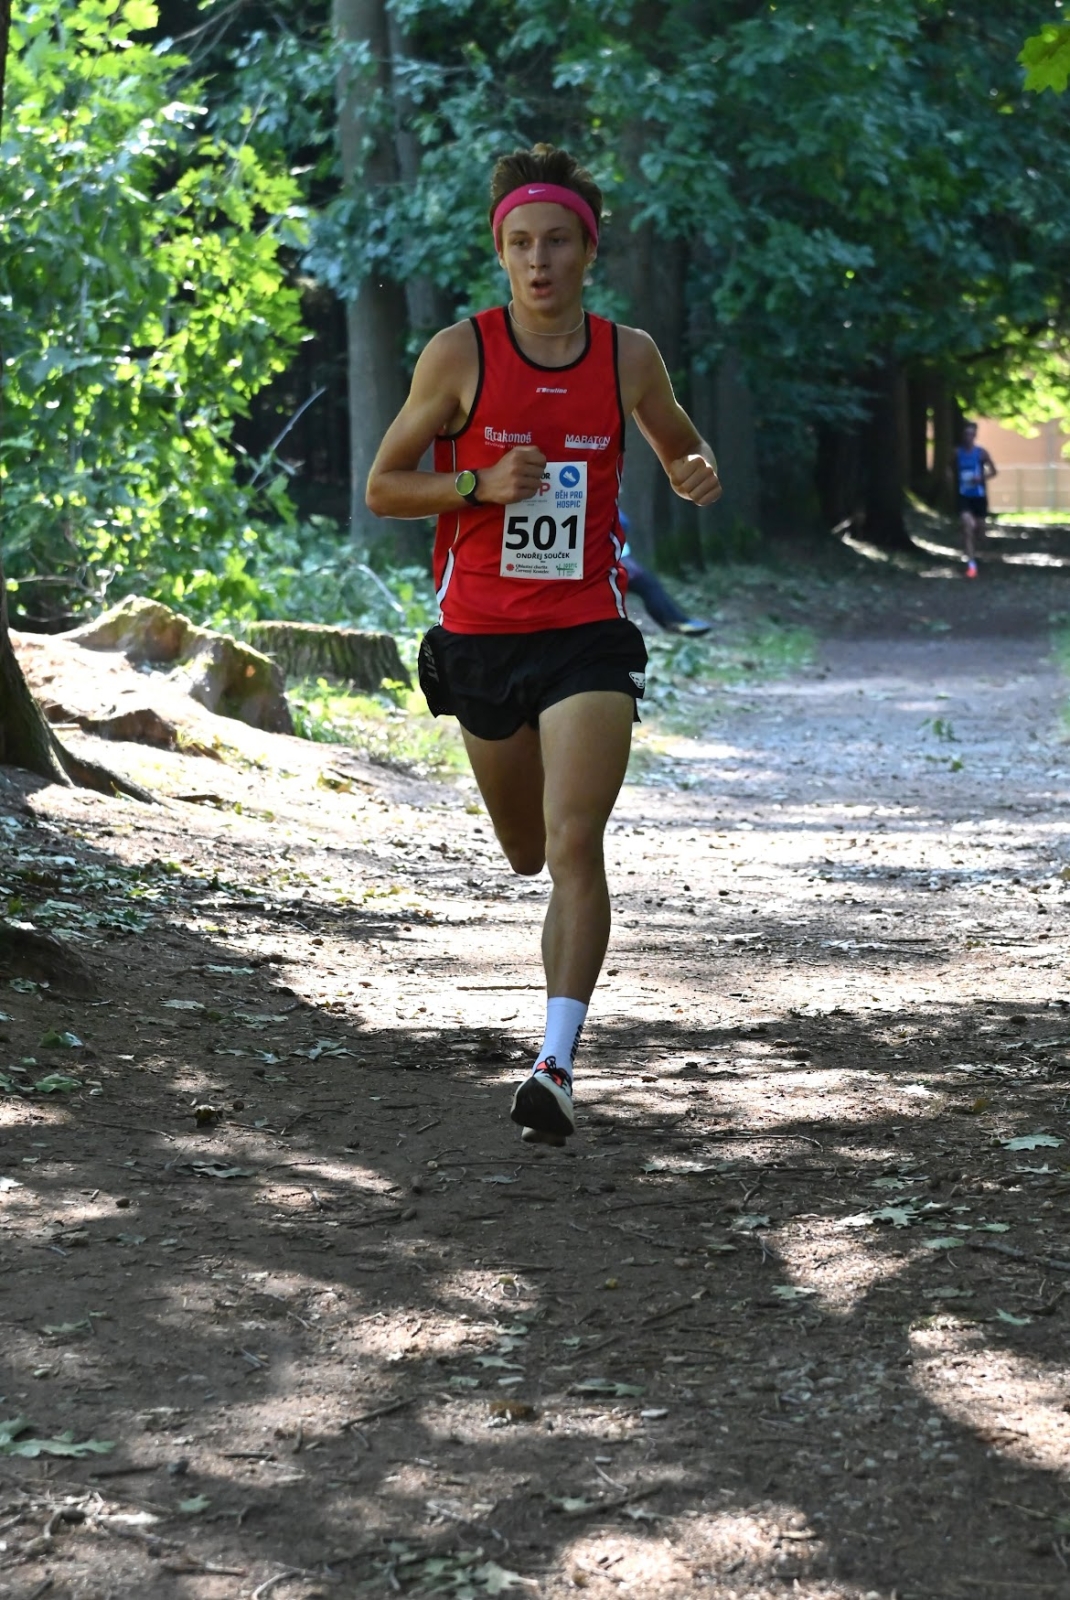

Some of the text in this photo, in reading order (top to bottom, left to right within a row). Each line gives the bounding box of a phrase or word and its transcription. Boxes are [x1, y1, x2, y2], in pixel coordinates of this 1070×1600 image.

[484, 426, 532, 444] Krakonoš
[565, 434, 611, 445] MARATON
[555, 490, 583, 500] BĚH PRO
[556, 500, 581, 508] HOSPIC
[505, 515, 578, 550] 501
[516, 551, 570, 560] ONDŘEJ SOUČEK
